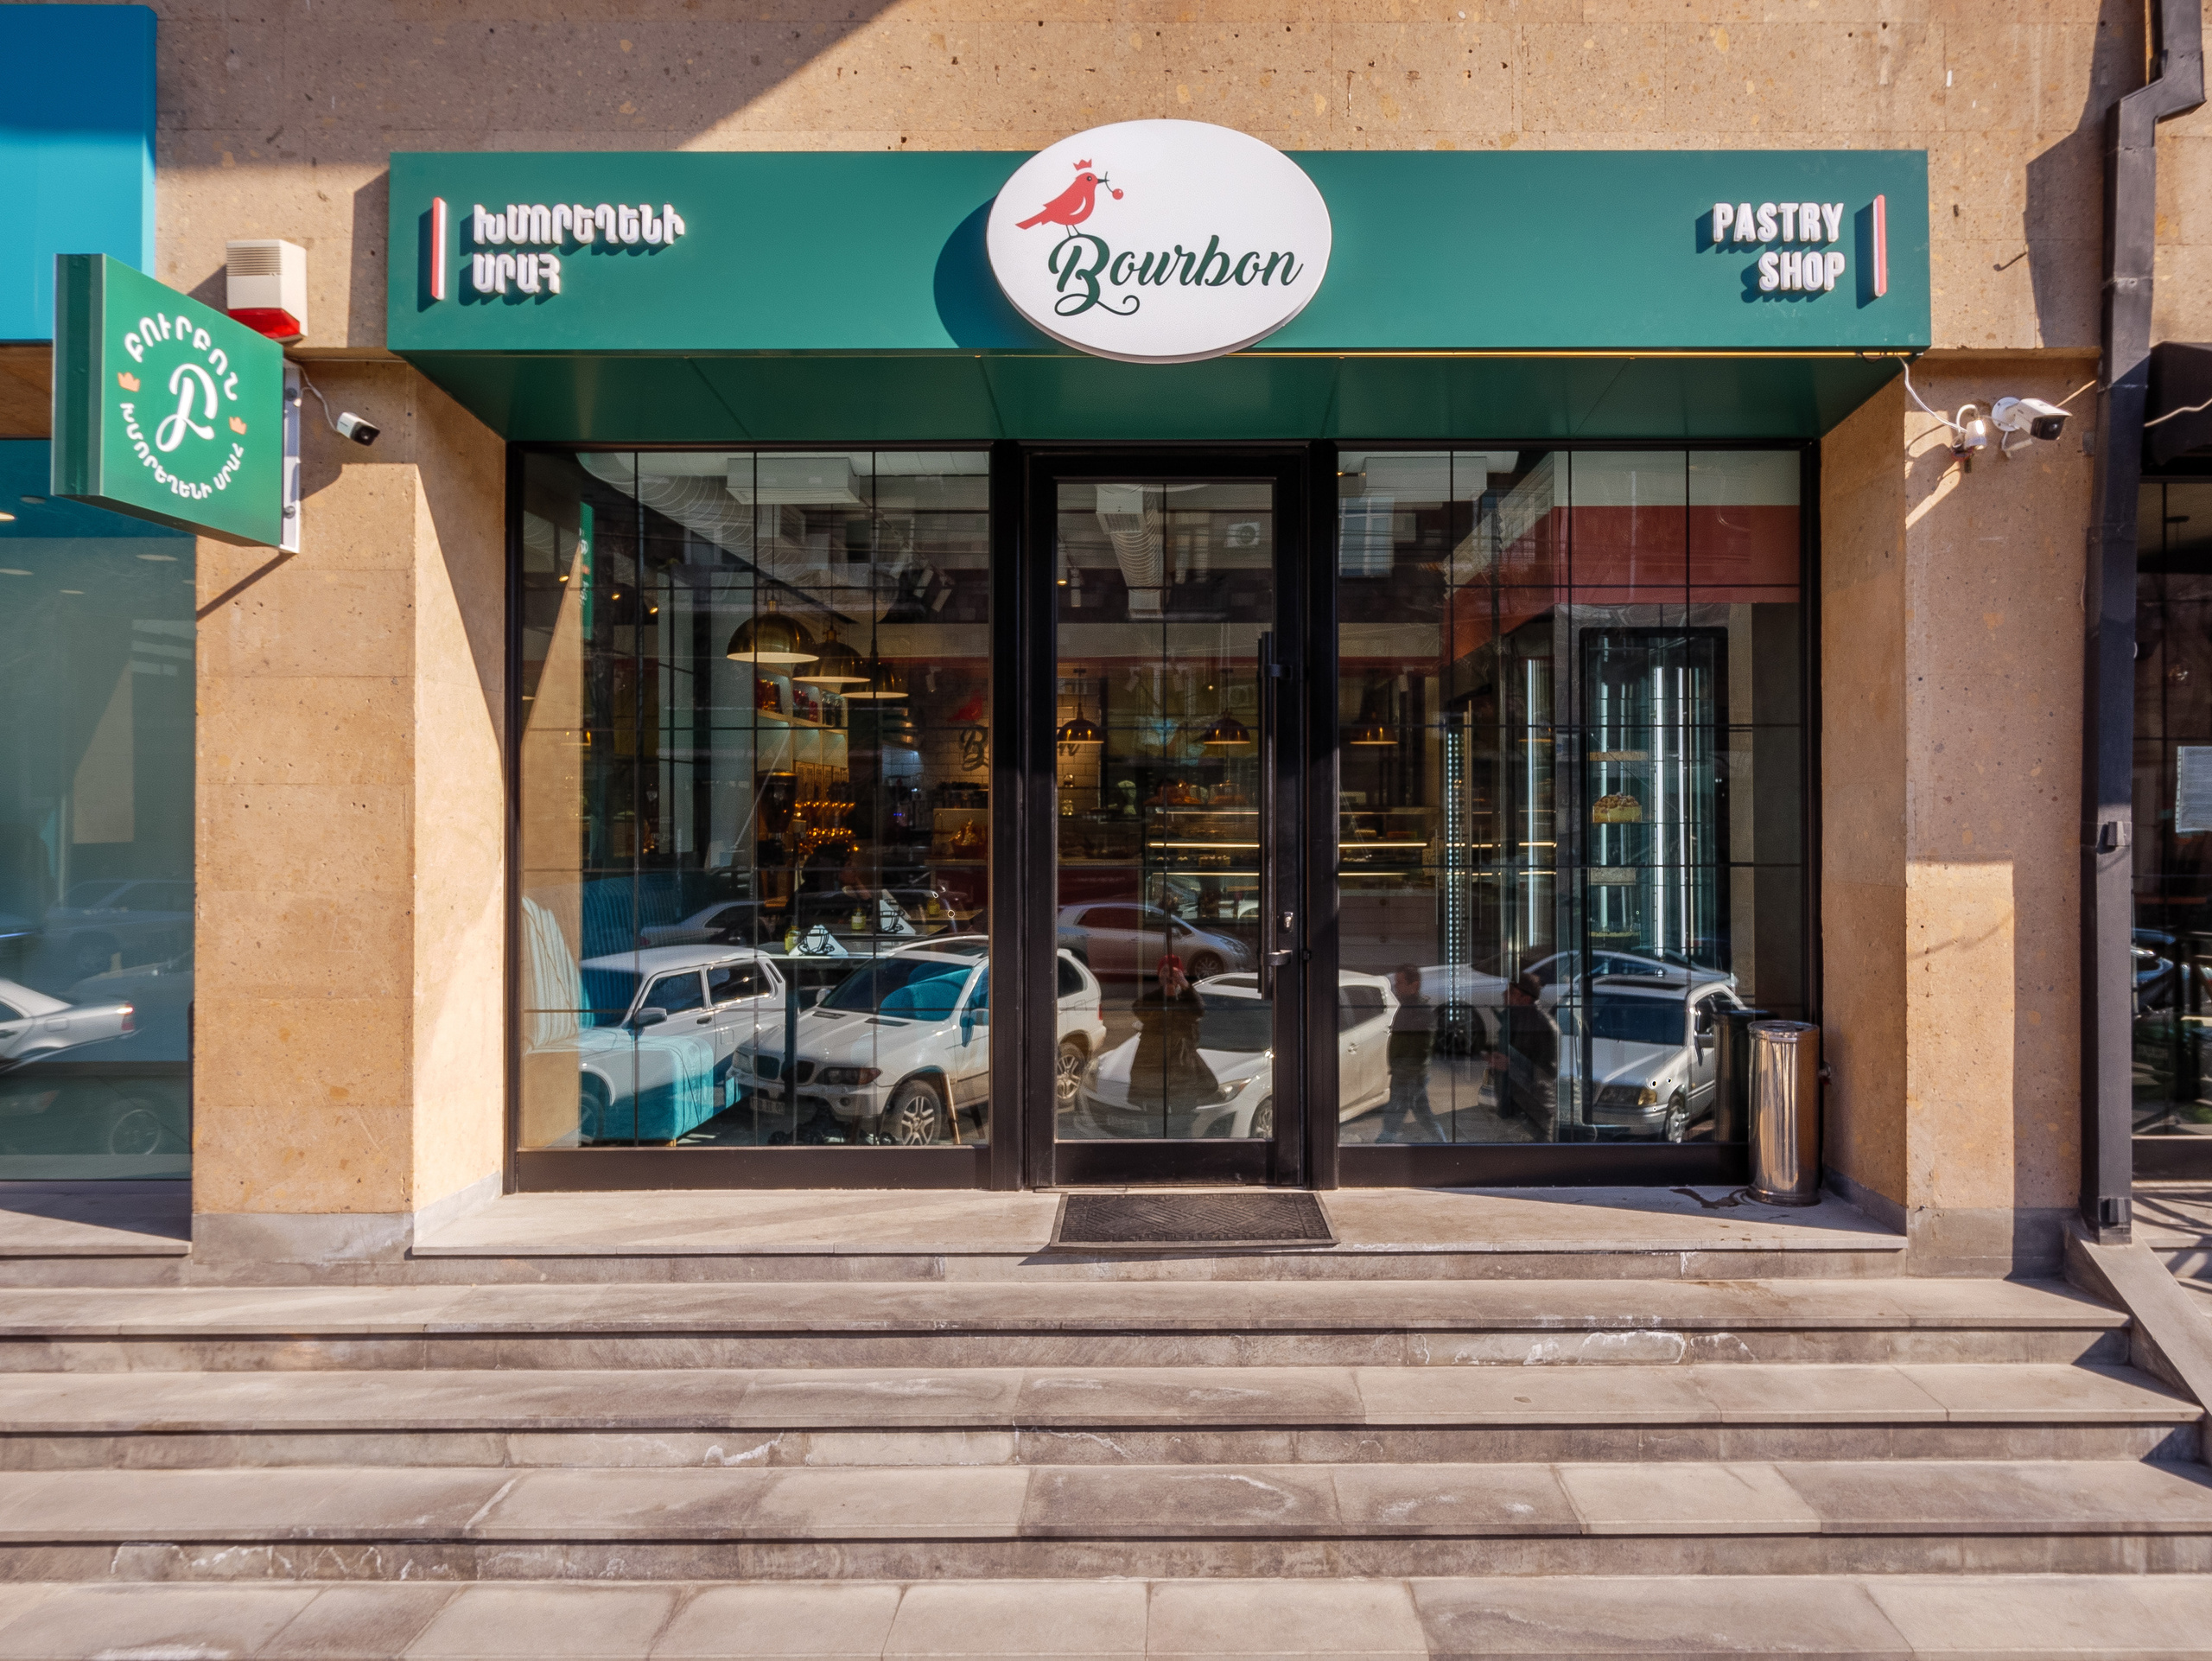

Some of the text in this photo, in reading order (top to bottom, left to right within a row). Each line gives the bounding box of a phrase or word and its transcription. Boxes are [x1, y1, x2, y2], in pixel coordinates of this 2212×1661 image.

[1713, 202, 1844, 243] PASTRY
[1048, 233, 1304, 316] Bourbon
[1758, 251, 1846, 291] SHOP
